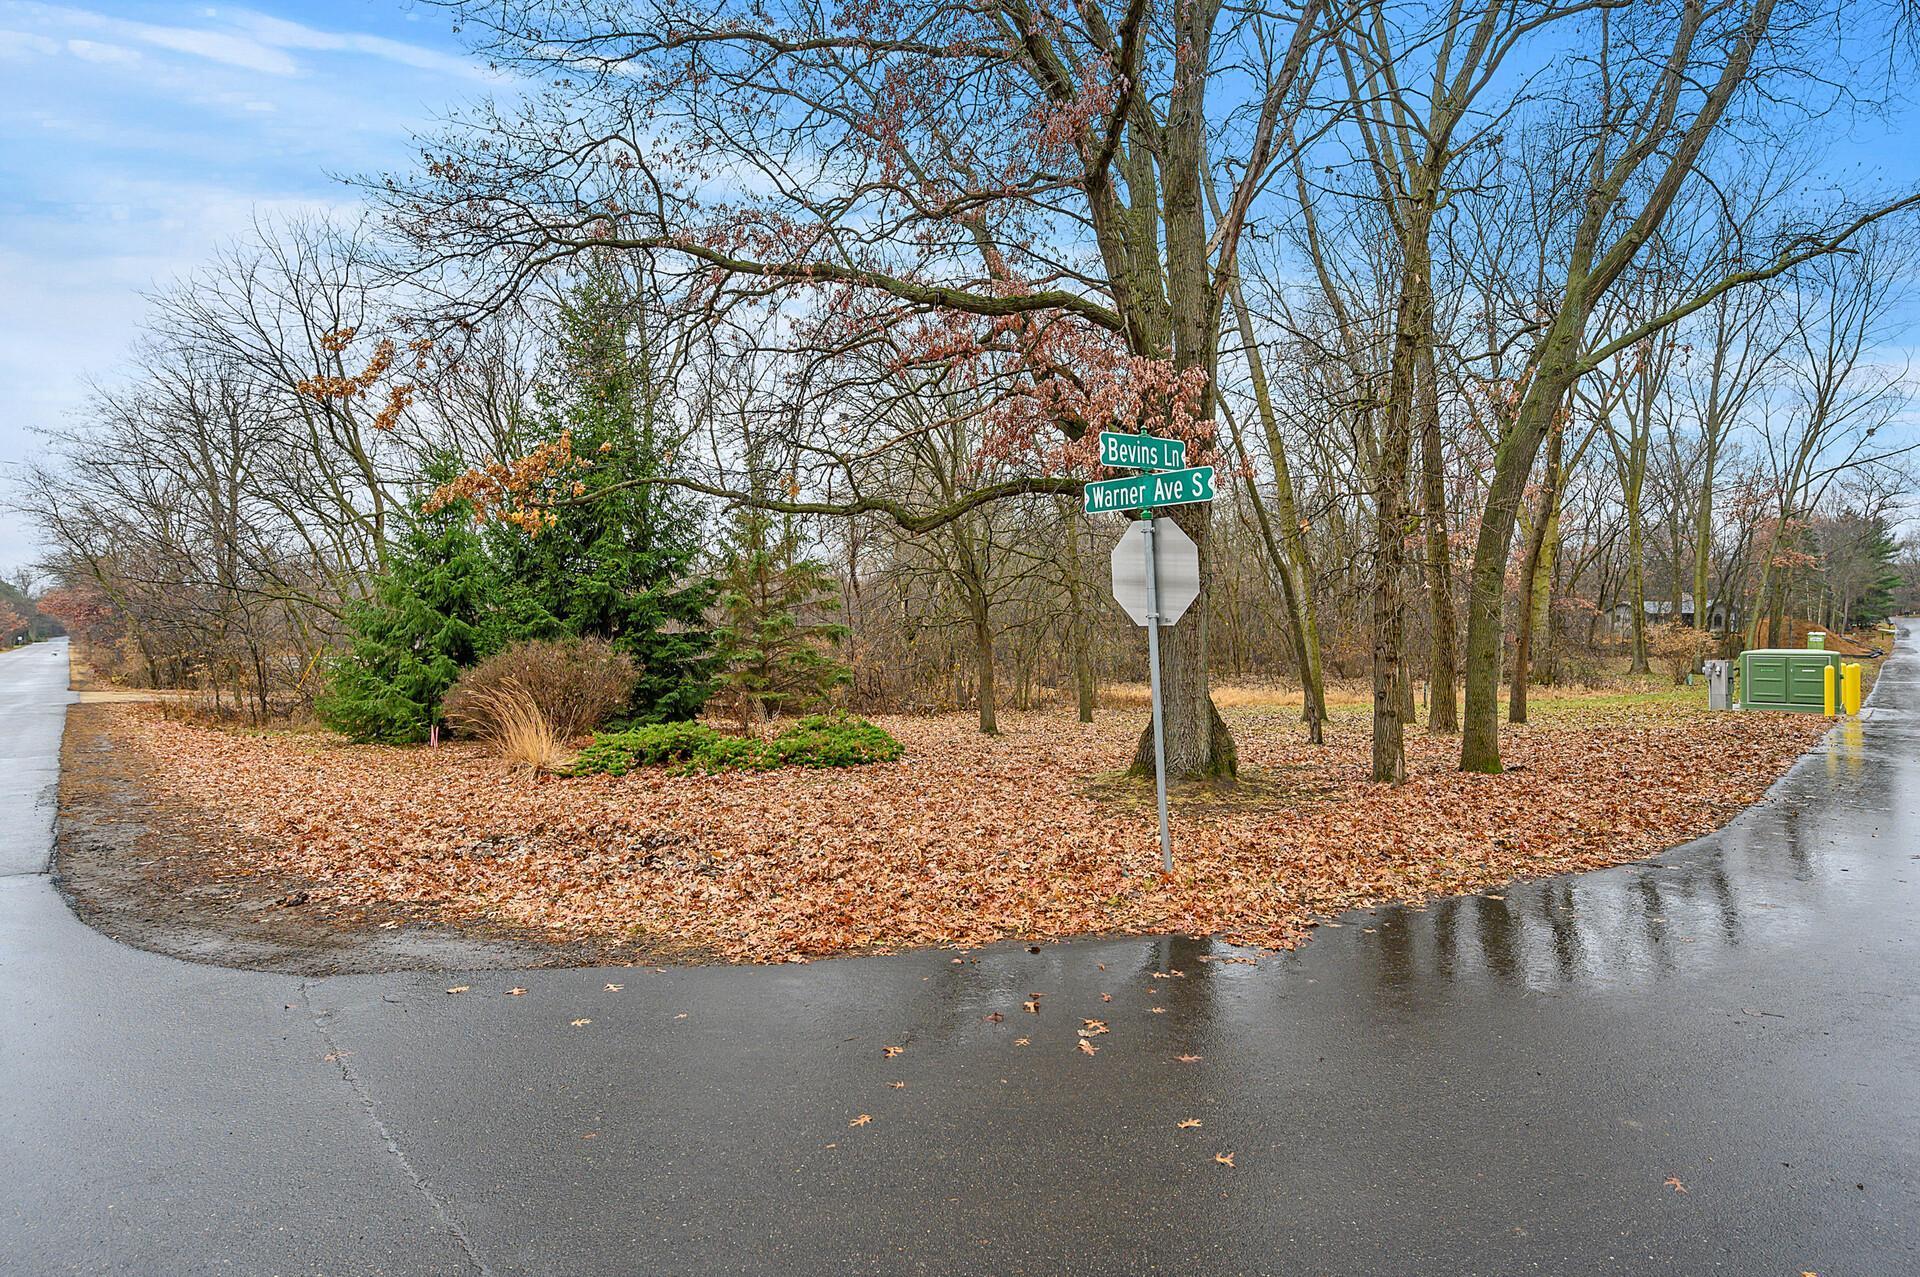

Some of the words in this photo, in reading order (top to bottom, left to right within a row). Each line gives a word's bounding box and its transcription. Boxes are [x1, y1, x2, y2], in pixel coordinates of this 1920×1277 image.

[1108, 437, 1158, 465] Bevins
[1164, 443, 1180, 467] Ln
[1092, 485, 1146, 509] Warner
[1154, 478, 1183, 502] Ave
[1191, 472, 1203, 497] S
